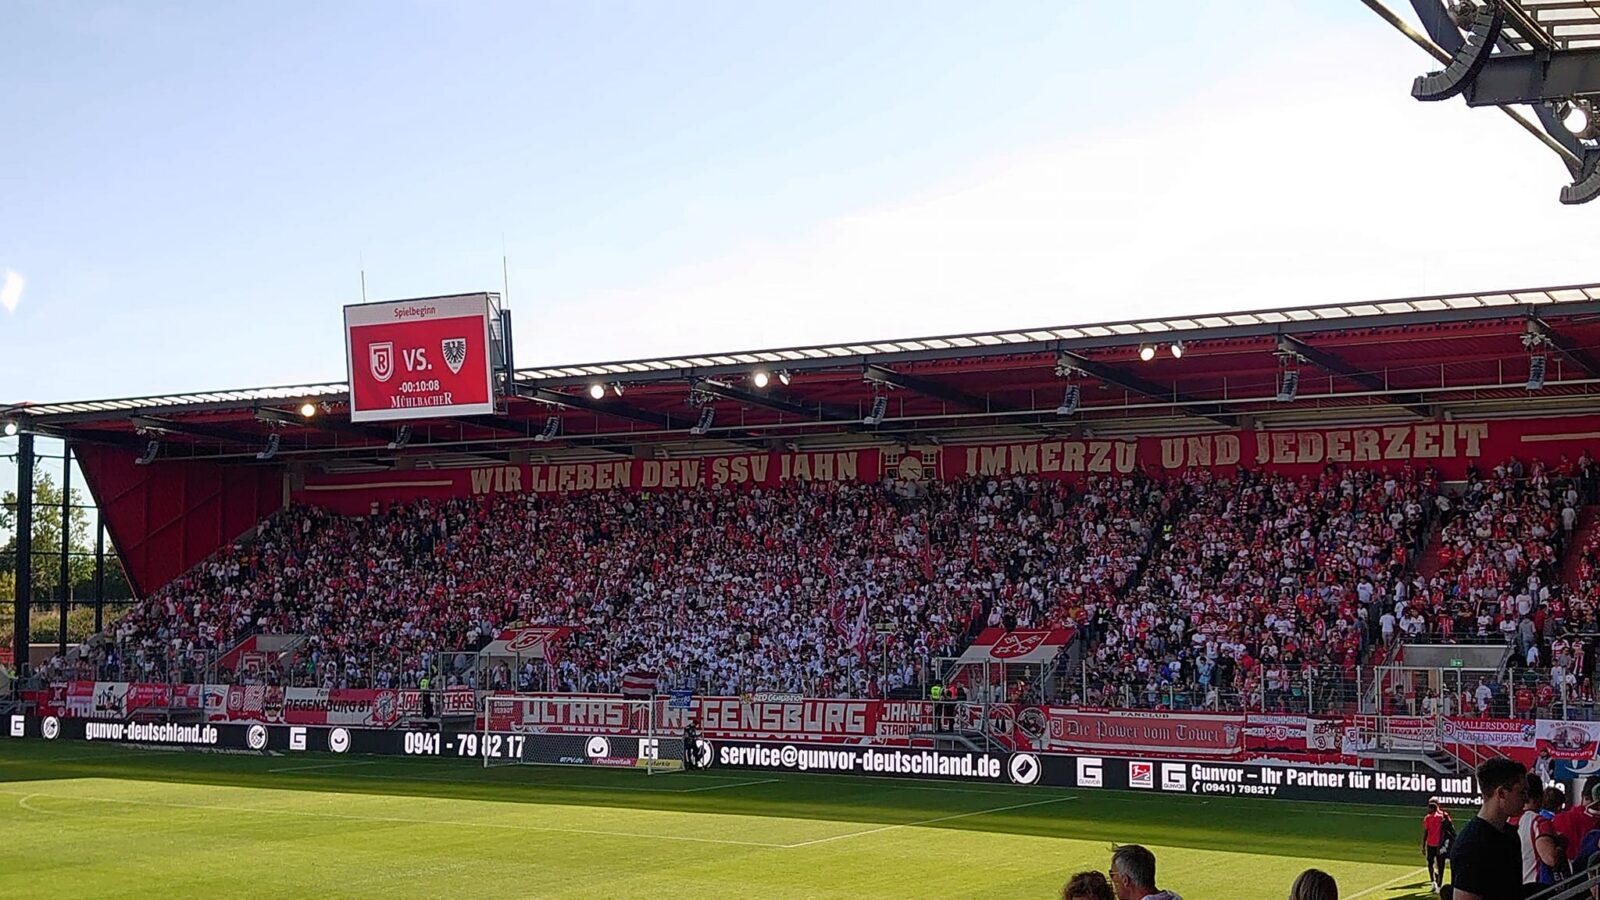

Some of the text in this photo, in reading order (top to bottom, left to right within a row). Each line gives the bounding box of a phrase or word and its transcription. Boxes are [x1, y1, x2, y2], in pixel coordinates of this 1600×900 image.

[394, 305, 436, 318] Spielbeginn
[403, 347, 433, 371] VS.
[399, 379, 440, 393] -00:10:08
[390, 392, 453, 408] MÜHLBACHER
[471, 422, 1489, 495] WIR LIEBEN DEN SSV JAHN IMMERZU UND JEDERZEIT
[285, 698, 358, 714] REGENSBURG
[523, 699, 624, 727] ULTRAS
[661, 699, 866, 734] REGENSBURG
[881, 702, 922, 722] JAHN
[85, 720, 218, 744] gunvor-deutschland.de
[1067, 719, 1221, 742] Die Power vom Tower
[1456, 720, 1521, 731] MALLERSDORF
[404, 731, 440, 755] 0941
[457, 734, 478, 756] 79
[506, 736, 525, 758] 17
[720, 743, 1001, 778] service@gunvor-deutschland.de
[1191, 763, 1243, 782] Gunvor
[1261, 767, 1283, 785] Ihr
[1287, 768, 1345, 788] Partner
[1349, 771, 1371, 790] für
[1375, 772, 1437, 792] Heizöle
[1441, 776, 1472, 793] und
[1202, 782, 1277, 796] (0941) 798217
